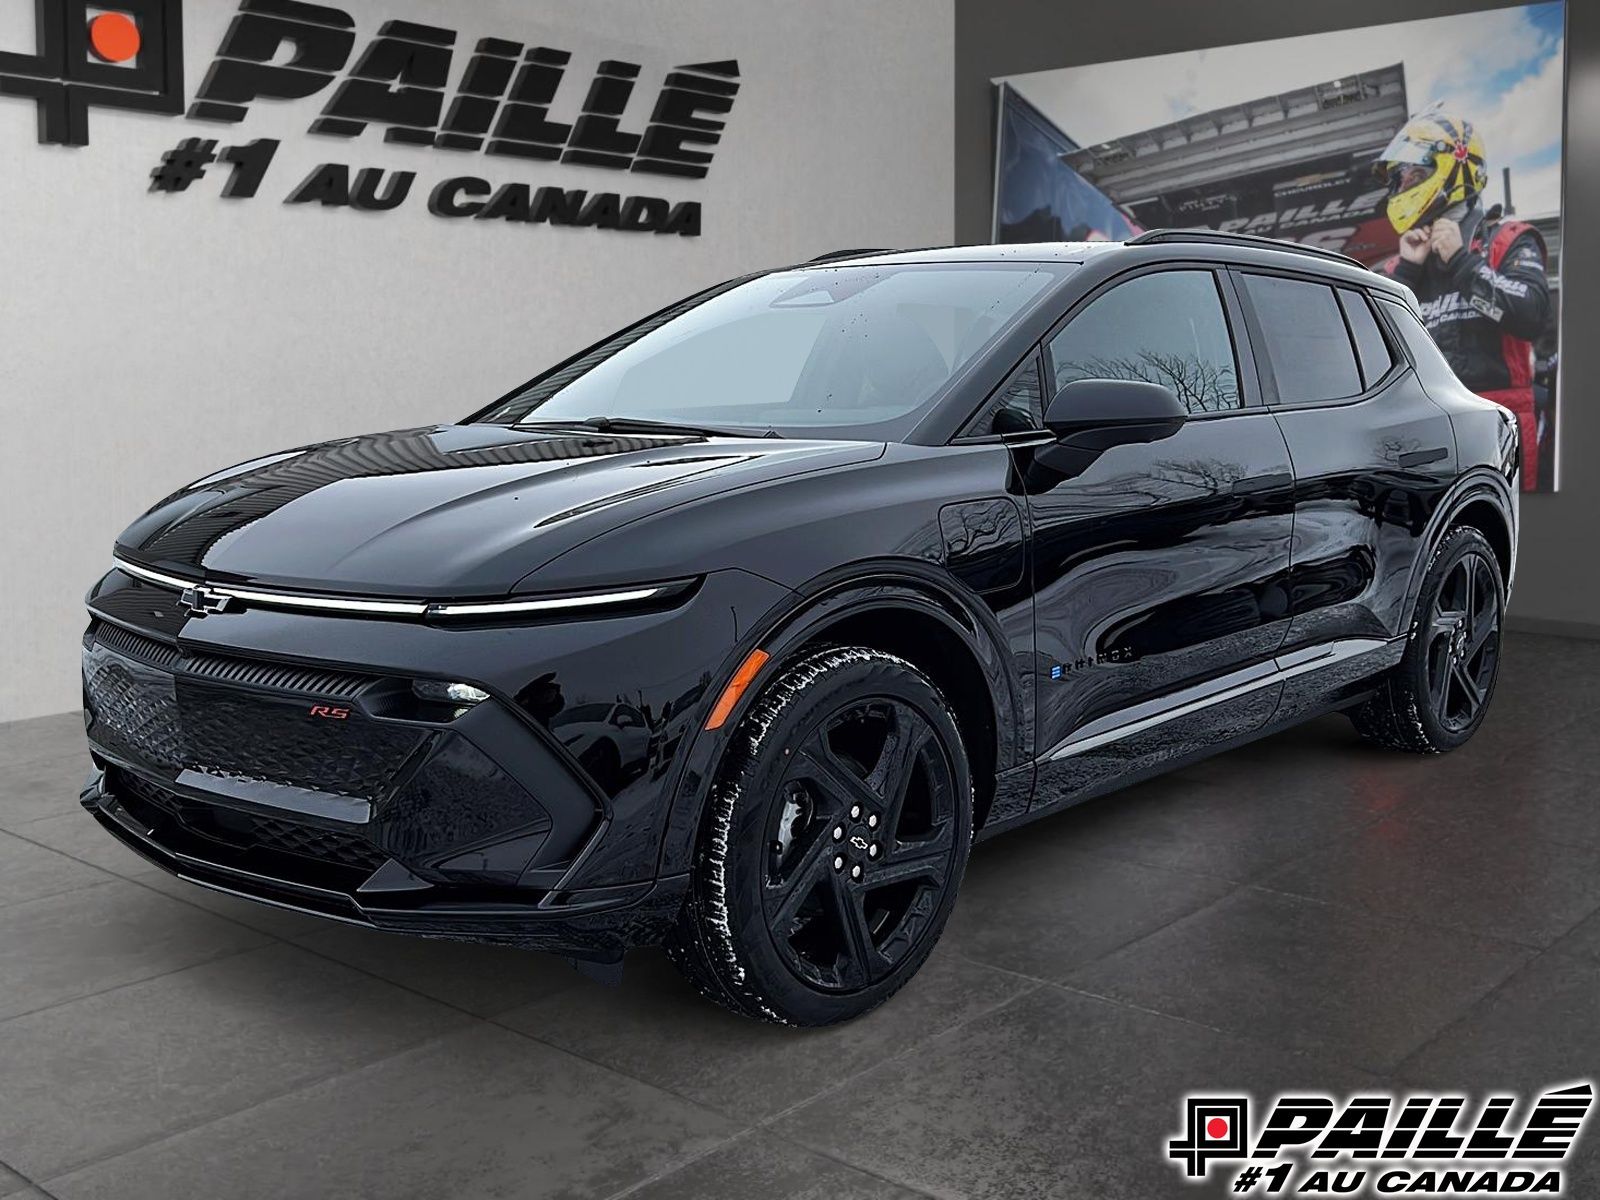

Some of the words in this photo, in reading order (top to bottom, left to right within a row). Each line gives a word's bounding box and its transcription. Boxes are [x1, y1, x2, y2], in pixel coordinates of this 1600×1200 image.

[185, 0, 741, 179] PAILLÉ
[149, 138, 280, 199] #1
[283, 163, 416, 211] AU
[428, 176, 702, 236] CANADA
[309, 704, 351, 720] RS
